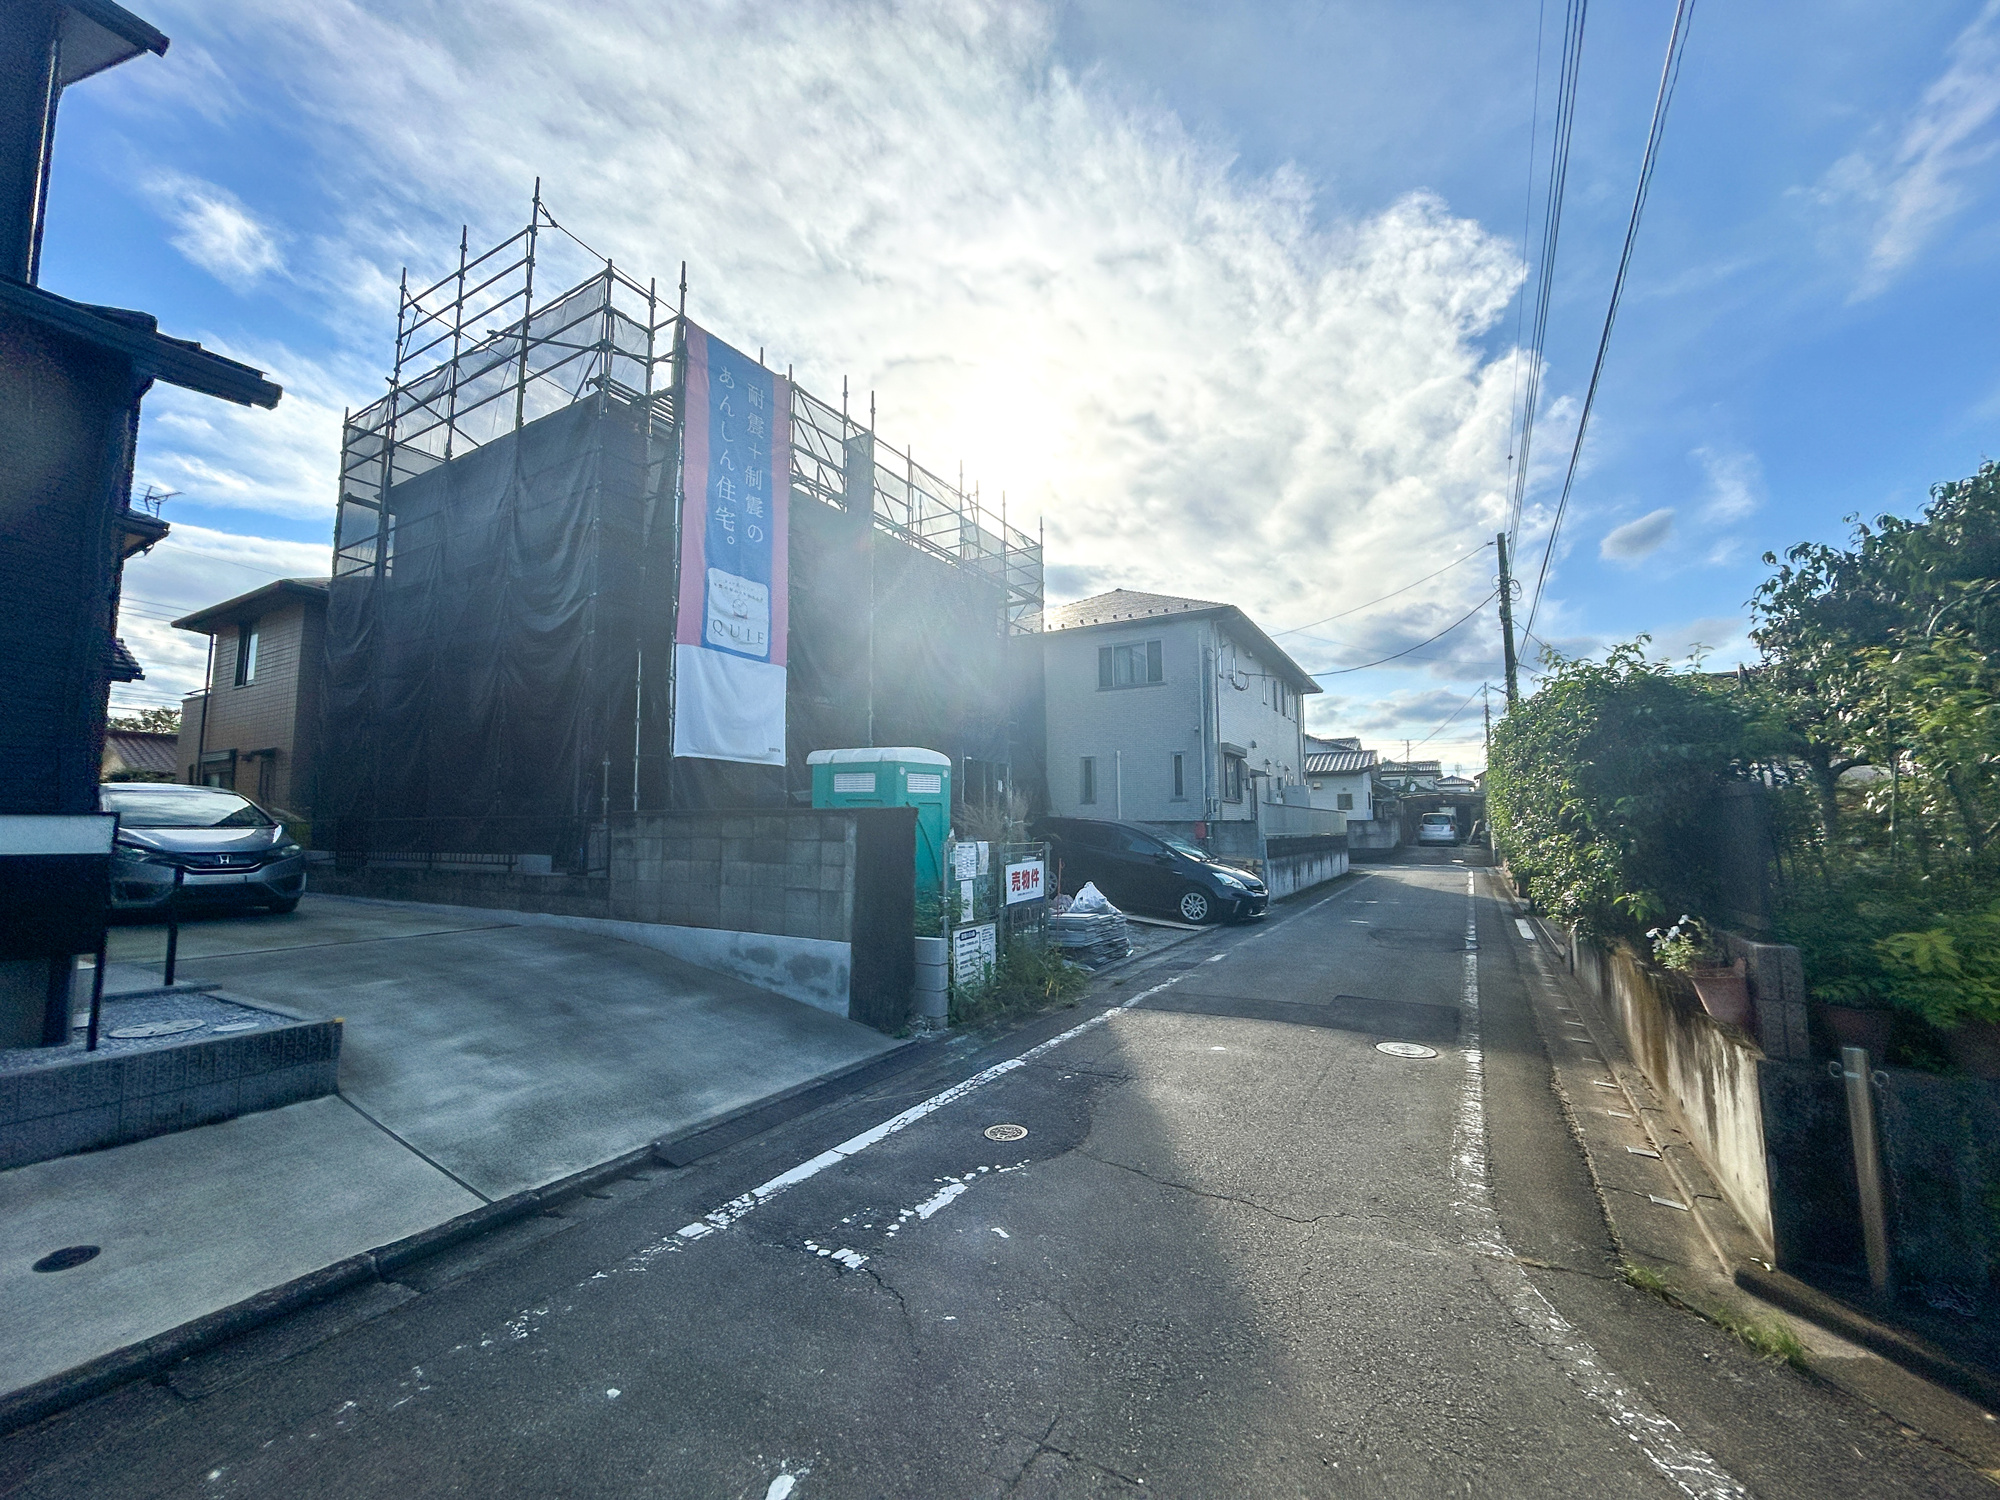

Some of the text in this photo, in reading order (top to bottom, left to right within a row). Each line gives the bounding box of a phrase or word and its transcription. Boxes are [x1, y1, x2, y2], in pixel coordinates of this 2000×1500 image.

[715, 366, 737, 545] あんしん住宅。
[745, 383, 765, 543] 耐震+制震の
[712, 619, 765, 645] QUIE
[1011, 867, 1040, 892] 売物件
